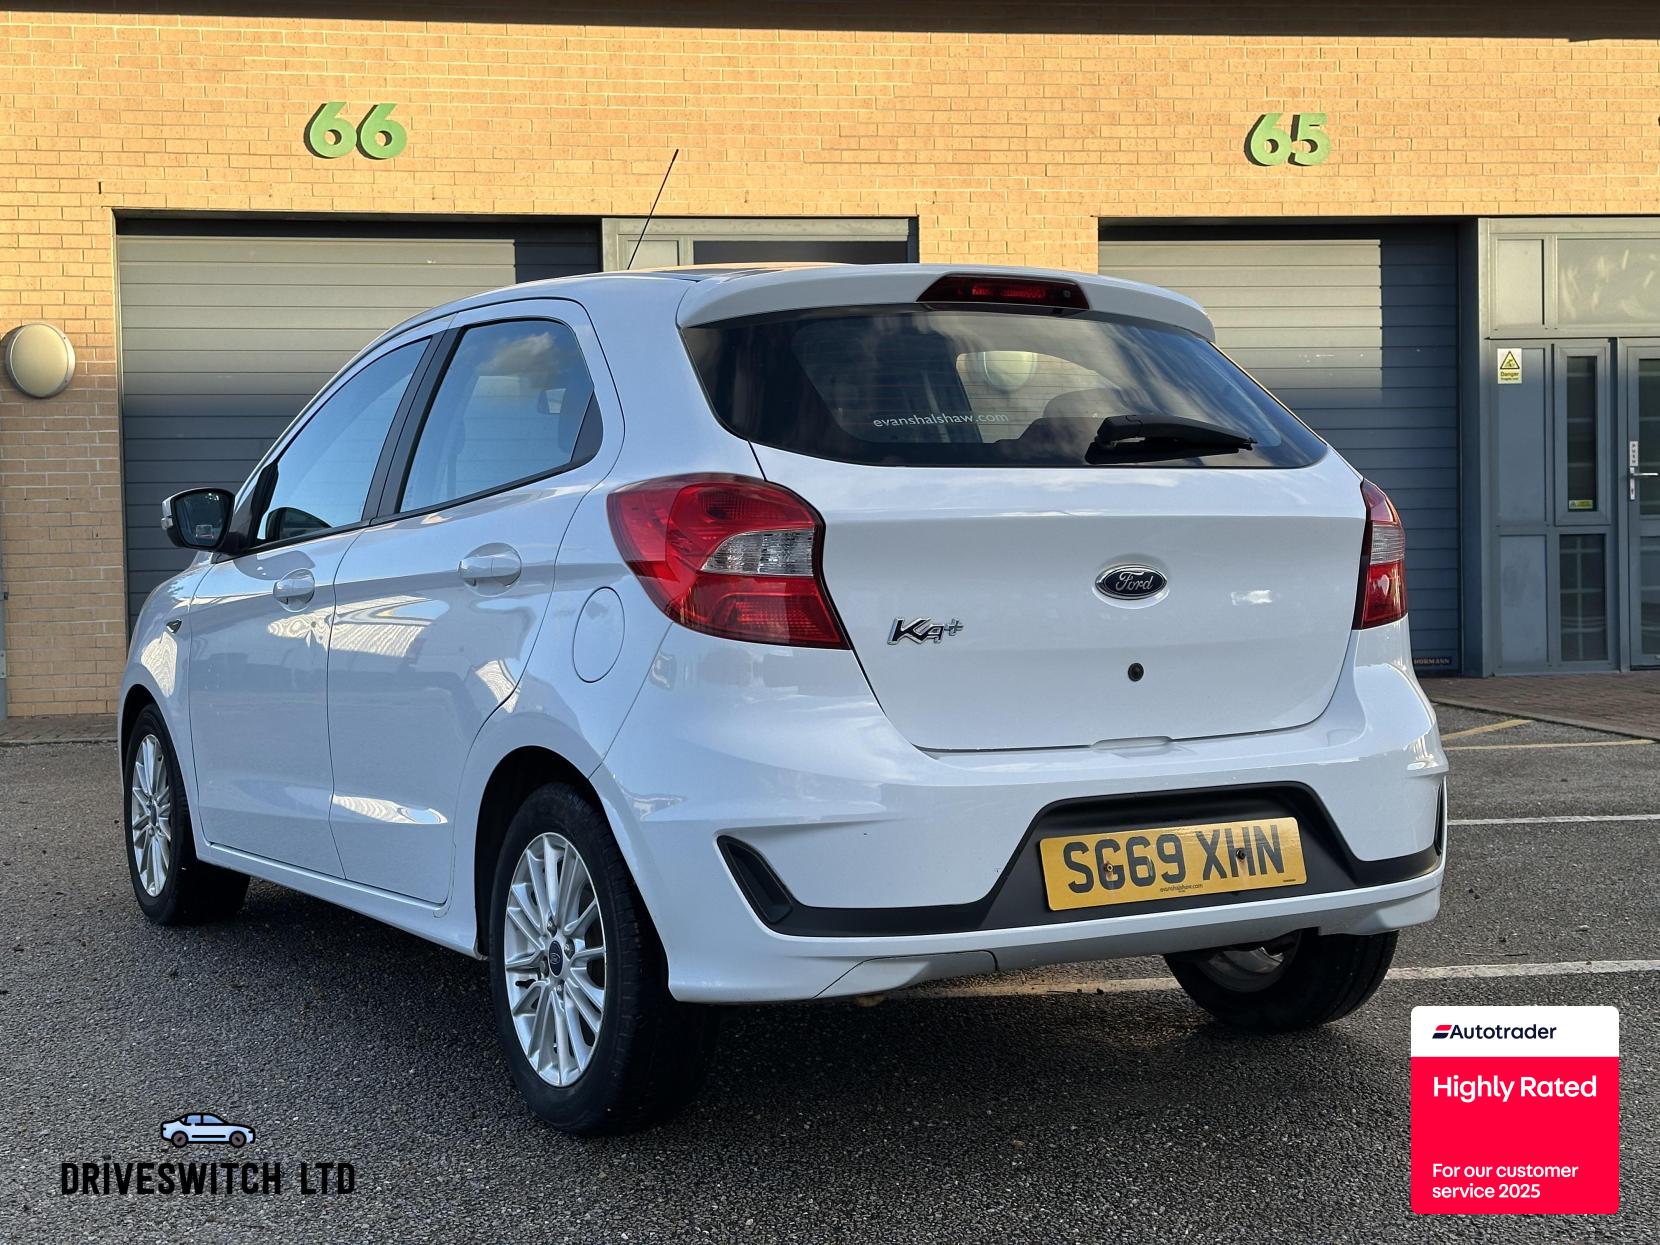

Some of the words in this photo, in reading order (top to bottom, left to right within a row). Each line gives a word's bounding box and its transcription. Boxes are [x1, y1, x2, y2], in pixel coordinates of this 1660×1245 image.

[304, 101, 408, 159] 66
[1245, 112, 1331, 166] 65
[873, 413, 1009, 428] evanshalshaw.com
[1115, 571, 1155, 591] Ford
[1063, 833, 1187, 894] SG69
[1195, 824, 1286, 881] XHN
